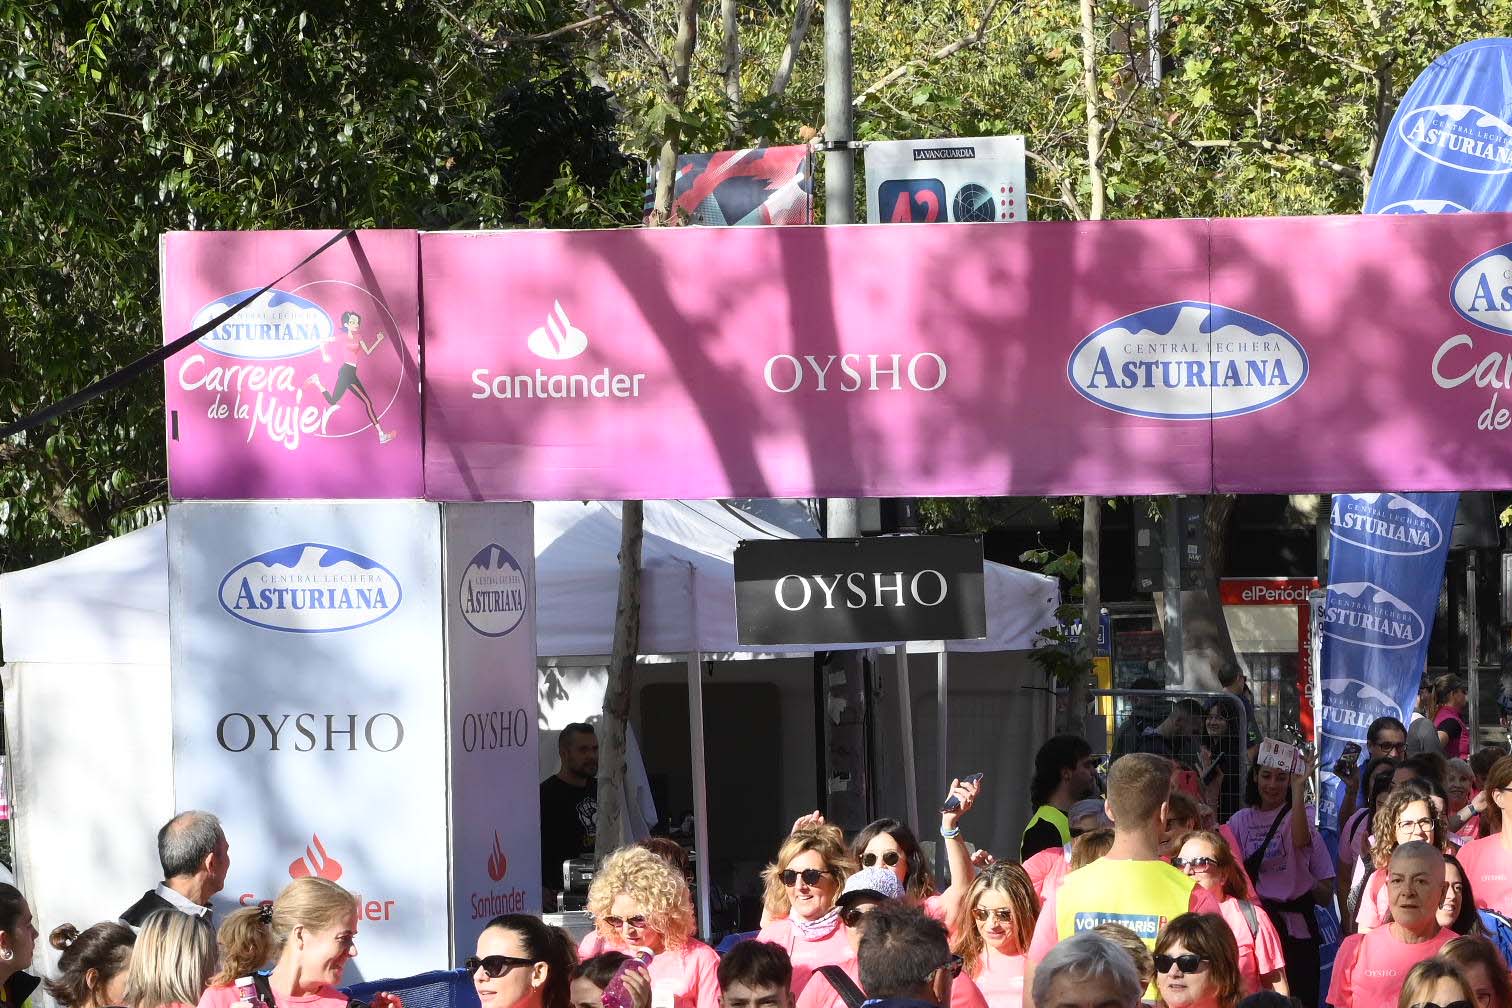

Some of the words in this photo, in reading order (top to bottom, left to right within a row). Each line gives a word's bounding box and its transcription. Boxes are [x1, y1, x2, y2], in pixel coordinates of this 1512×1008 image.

[202, 316, 322, 341] ASTURIANA
[1124, 343, 1199, 353] CENTRAL
[1207, 341, 1281, 353] LECHERA
[178, 355, 296, 393] Carrera
[471, 368, 645, 399] Santander
[763, 353, 947, 393] OYSHO
[1087, 346, 1290, 389] ASTURIANA
[207, 394, 229, 420] de
[234, 394, 249, 420] la
[246, 389, 342, 450] Mujer
[1478, 392, 1511, 431] de
[1330, 502, 1431, 547] ASTURIANA
[233, 576, 389, 611] ASTURIANA
[261, 574, 317, 584] CENTRAL
[324, 573, 383, 584] LECHERA
[465, 578, 523, 614] ASTURIANA
[775, 569, 948, 611] OYSHO
[216, 712, 405, 753] OYSHO
[463, 708, 528, 753] OYSHO
[471, 887, 526, 920] Santander
